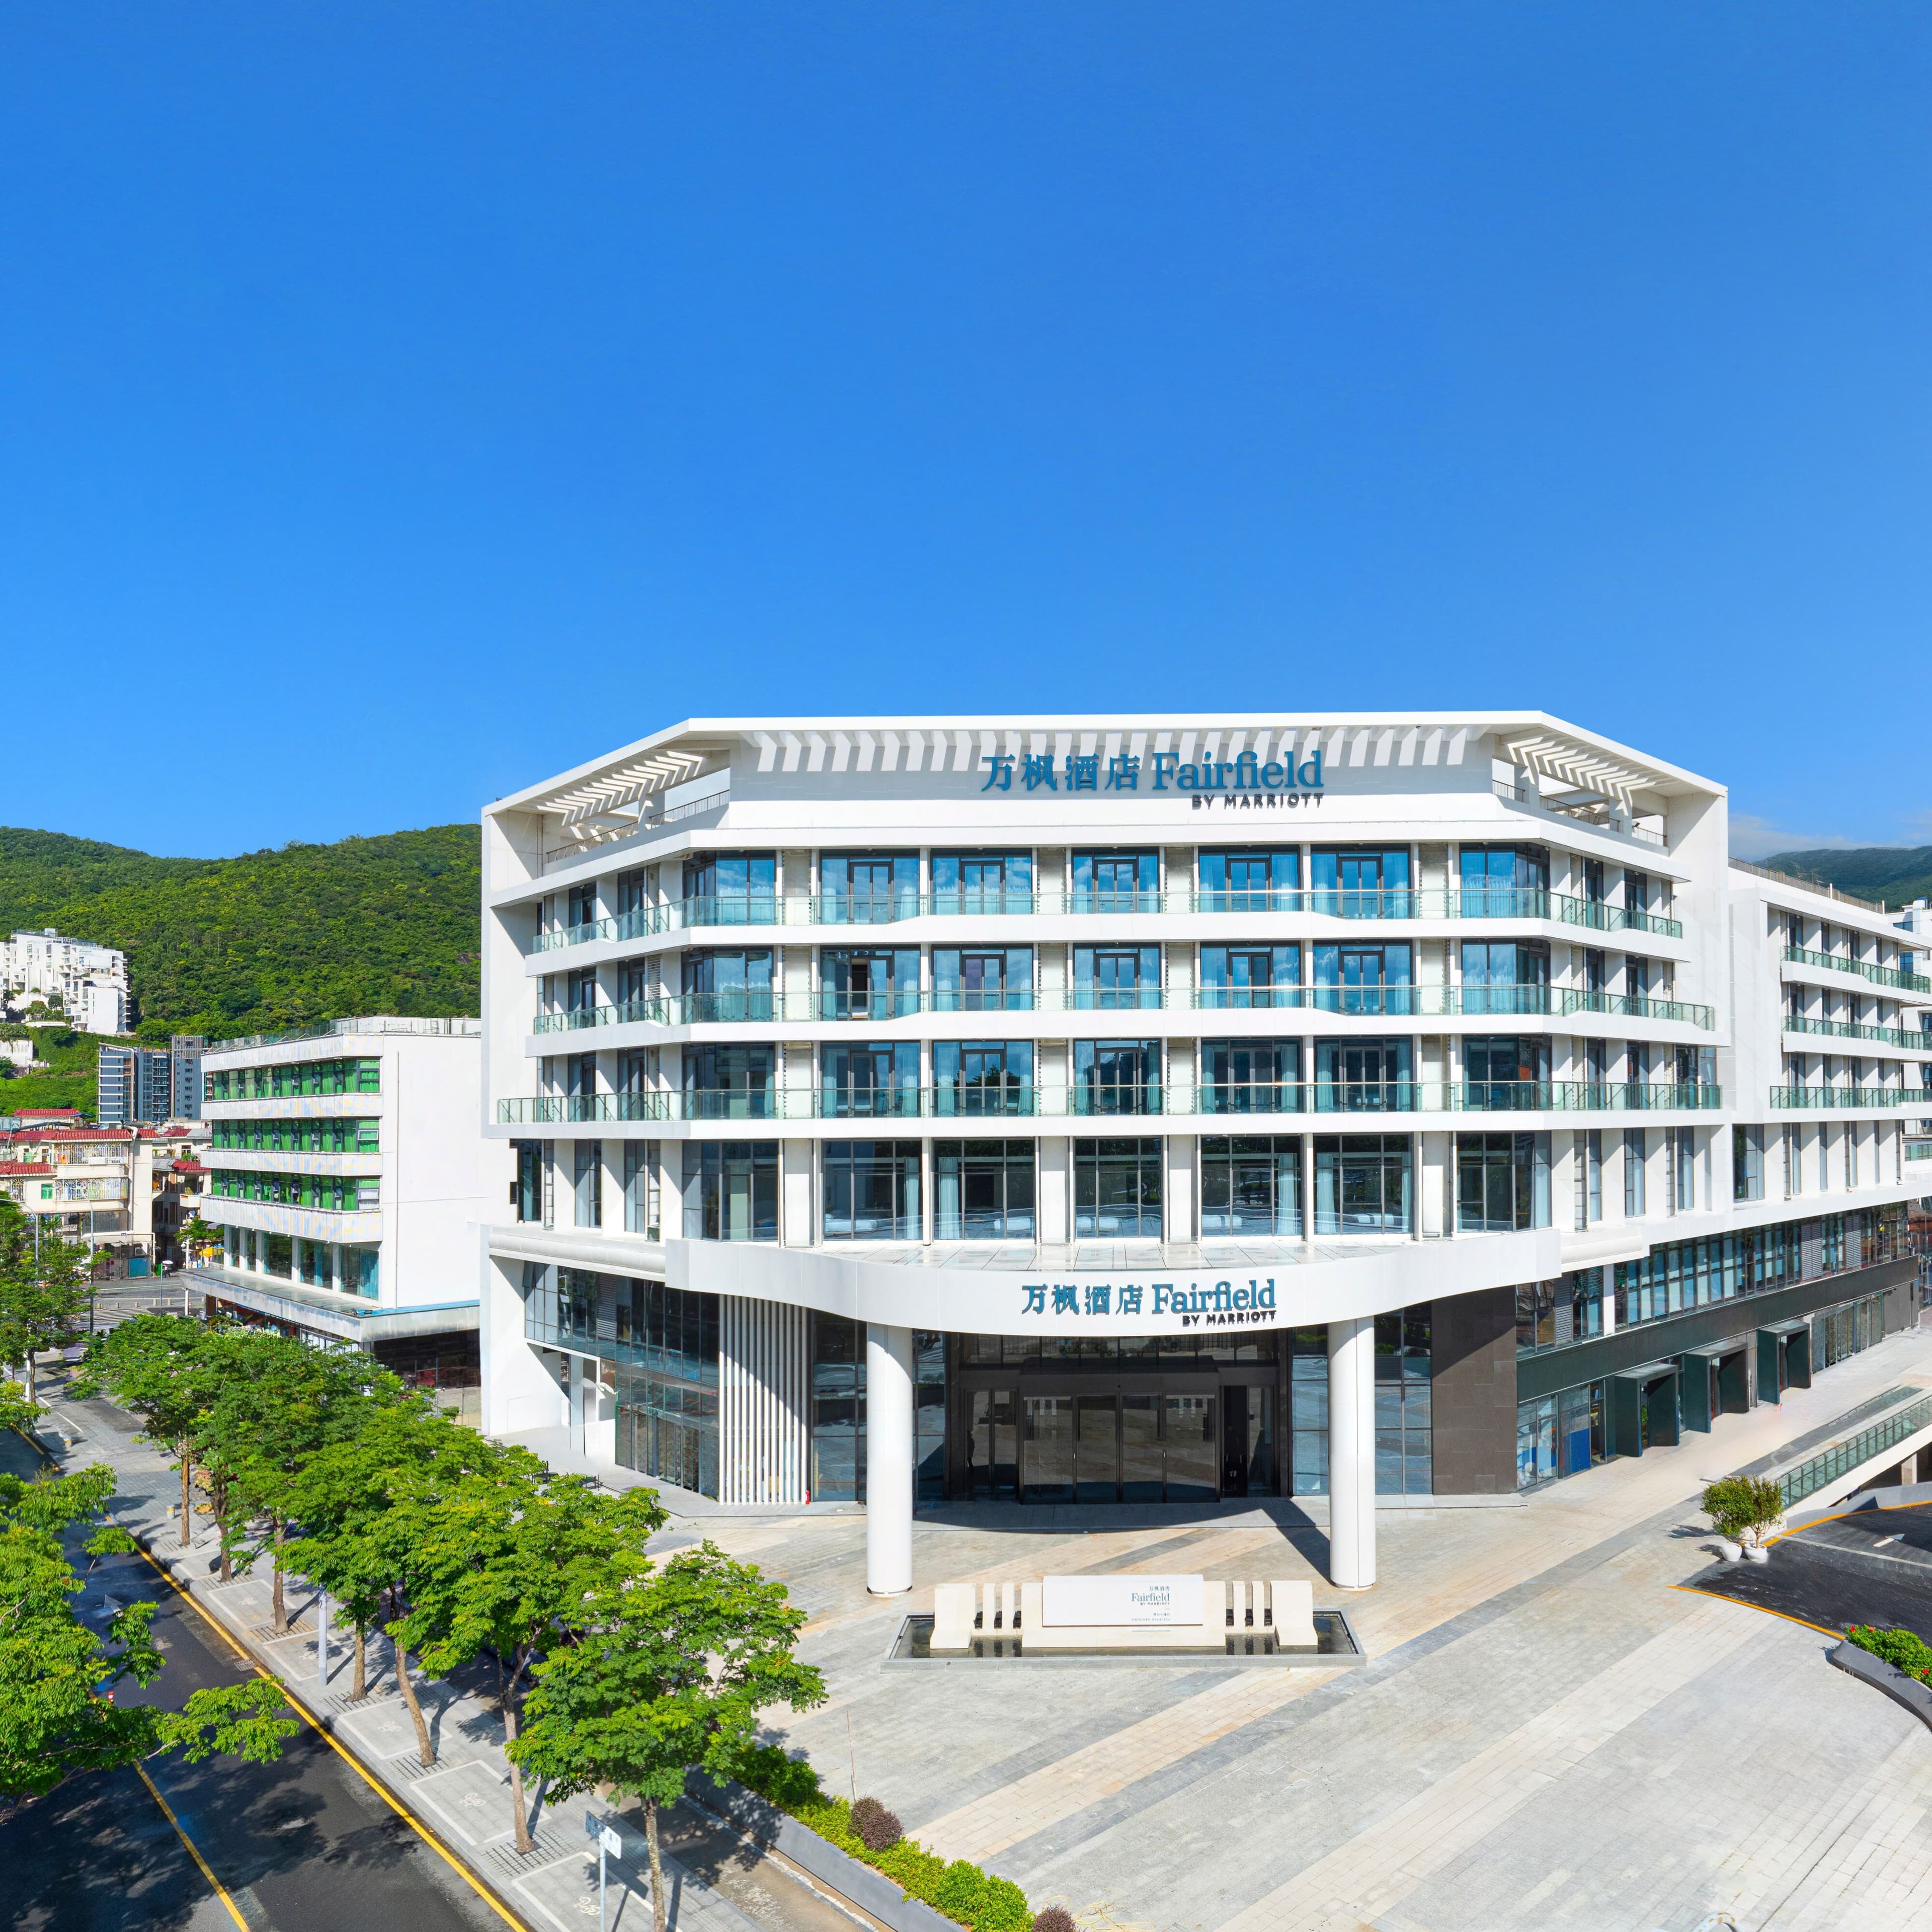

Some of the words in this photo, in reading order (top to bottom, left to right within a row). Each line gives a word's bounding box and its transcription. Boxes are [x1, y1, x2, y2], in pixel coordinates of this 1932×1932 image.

[982, 753, 1140, 792] 万枫酒店
[1152, 750, 1325, 790] Fairfield
[1192, 793, 1215, 809] BY
[1225, 792, 1324, 809] MARRIOTT
[1022, 1283, 1144, 1315] 万枫酒店
[1151, 1278, 1277, 1314] Fairfield
[1182, 1315, 1200, 1327] BY
[1206, 1310, 1277, 1326] MARRIOTT
[1132, 1593, 1170, 1602] Fairfield
